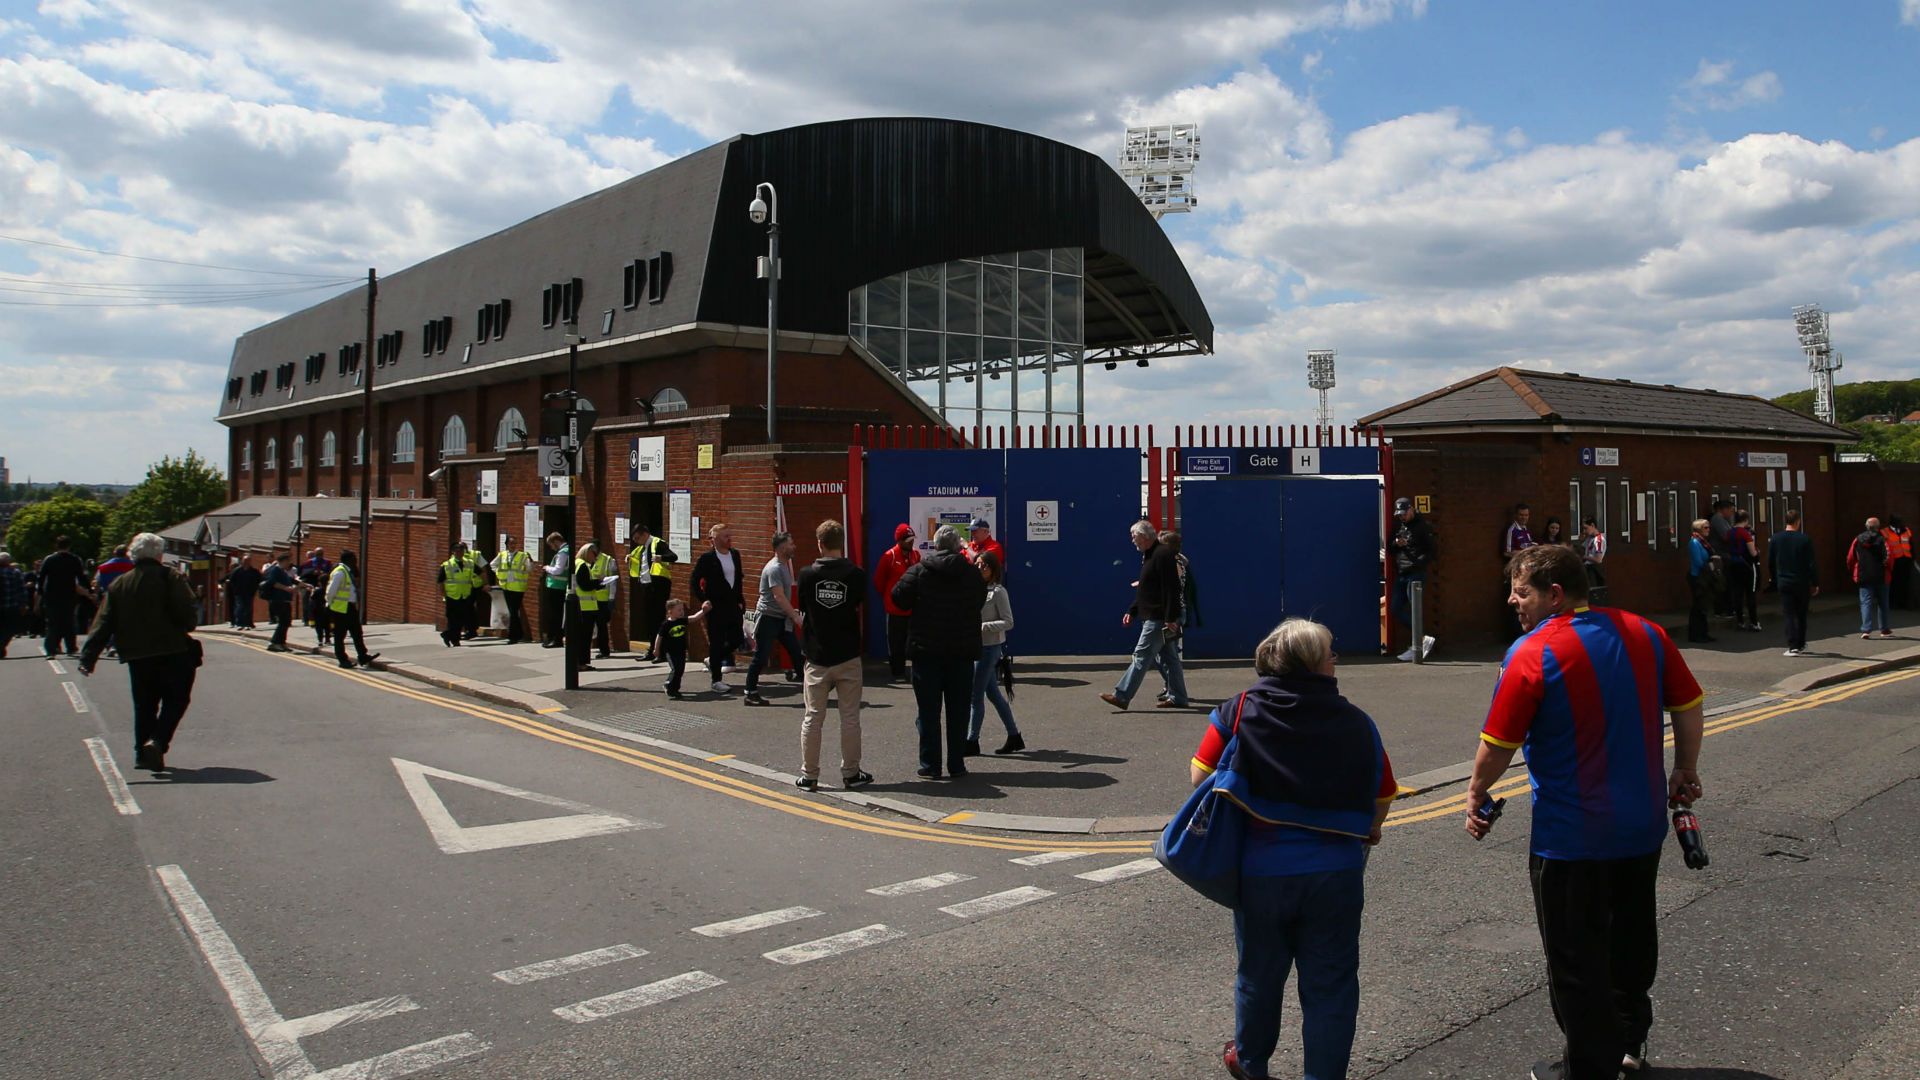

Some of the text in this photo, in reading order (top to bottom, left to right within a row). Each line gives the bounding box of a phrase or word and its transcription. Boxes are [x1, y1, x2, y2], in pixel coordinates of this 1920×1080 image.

[553, 451, 564, 466] 3
[1249, 454, 1311, 467] Gate H
[778, 482, 843, 495] INFORMATION
[928, 486, 979, 495] STADIUM MAP
